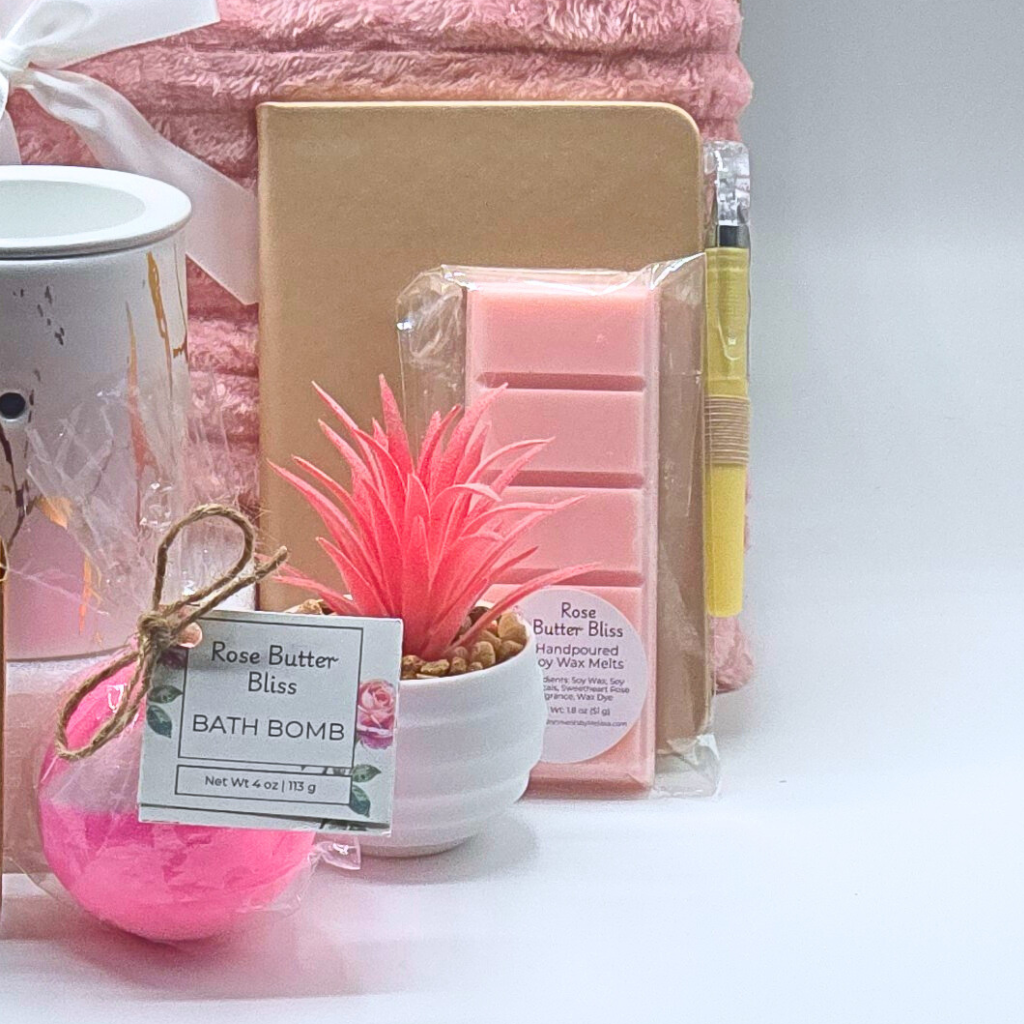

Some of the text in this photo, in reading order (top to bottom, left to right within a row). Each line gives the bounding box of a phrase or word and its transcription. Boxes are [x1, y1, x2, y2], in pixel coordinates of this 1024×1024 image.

[561, 602, 597, 619] Rose
[532, 619, 623, 638] Butter Bliss
[211, 641, 339, 669] Rose Butter
[535, 643, 619, 657] Handpoured
[537, 657, 624, 670] oy Wax Melts
[248, 672, 297, 695] Bliss
[596, 693, 614, 703] Dye
[192, 714, 345, 741] BATH BOMB
[205, 775, 227, 787] Net
[231, 776, 250, 788] Wt
[252, 778, 261, 788] 4
[264, 780, 278, 790] oz
[289, 780, 305, 792] 113
[308, 782, 316, 794] g
